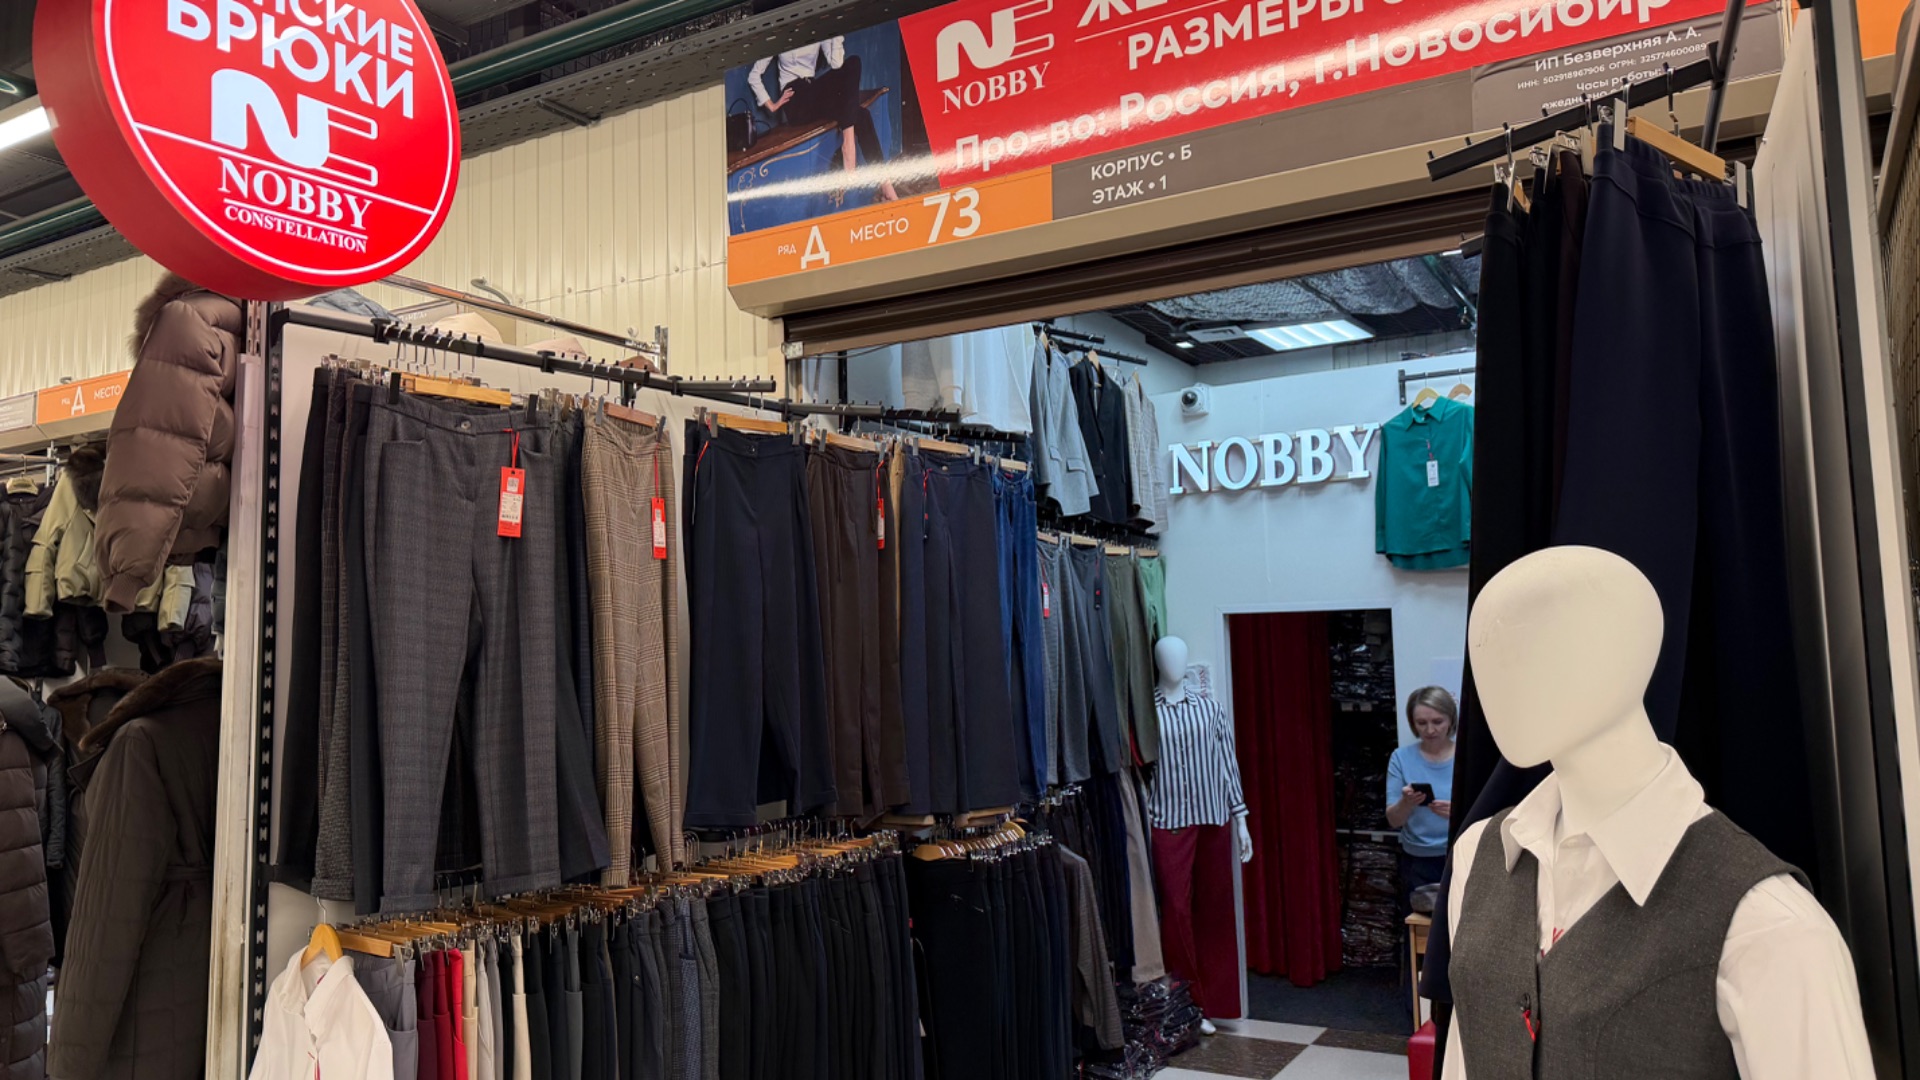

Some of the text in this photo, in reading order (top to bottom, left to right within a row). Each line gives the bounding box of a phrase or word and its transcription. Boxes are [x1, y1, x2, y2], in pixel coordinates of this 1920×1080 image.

[252, 0, 413, 66] СКИЕ
[1535, 26, 1702, 72] ИП Безверхняя А. А.
[167, 0, 413, 119] БРЮКИ
[1517, 78, 1540, 91] ИНН:
[1608, 57, 1637, 70] ОГРН:
[1640, 42, 1707, 64] 325774600089
[941, 62, 1050, 114] NOBBY
[1576, 78, 1609, 92] Часы
[955, 111, 1106, 171] Про-во:
[1119, 64, 1301, 131] Россия,
[1091, 144, 1192, 180] КОРПУС Б
[215, 156, 372, 230] NOBBY
[1092, 175, 1168, 204] ЭТАЖ 1
[224, 205, 367, 254] CONSTELLATION
[778, 187, 981, 270] РЯД Д МЕСТО 73
[71, 385, 86, 416] Д
[93, 384, 122, 400] МЕСТО
[1168, 422, 1380, 495] NOBBY
